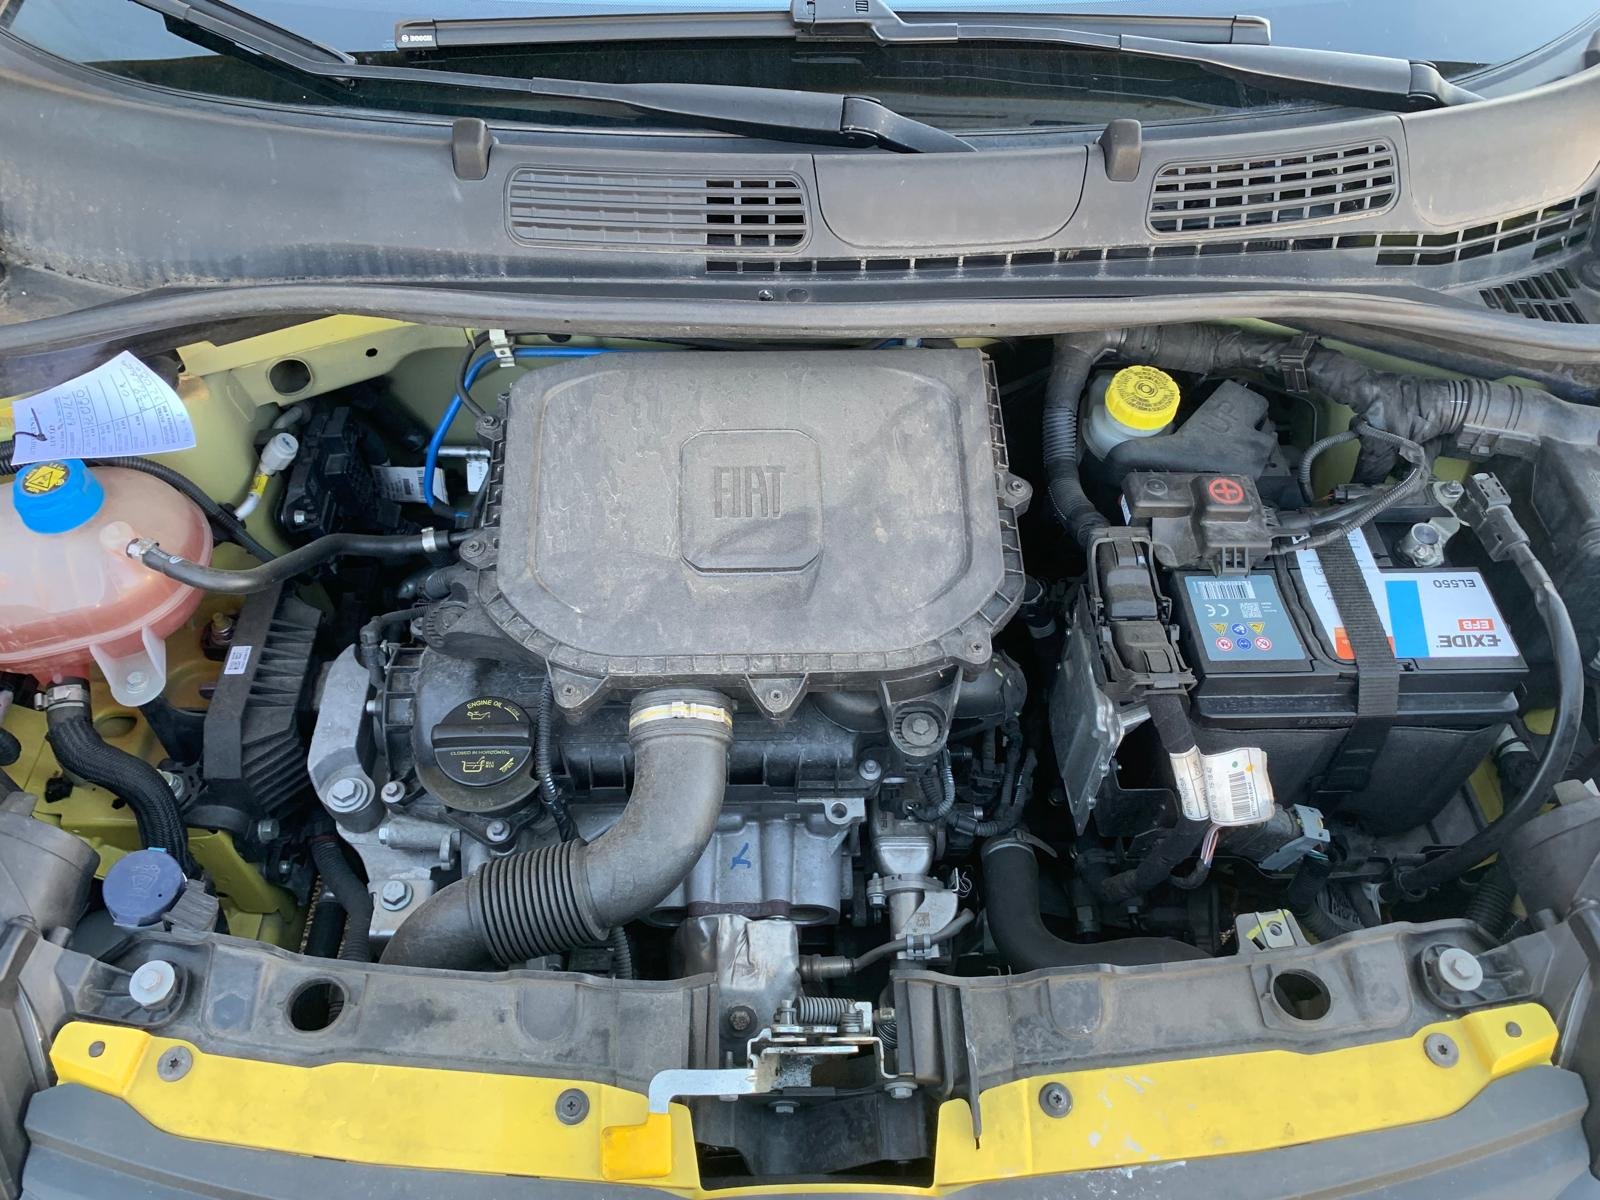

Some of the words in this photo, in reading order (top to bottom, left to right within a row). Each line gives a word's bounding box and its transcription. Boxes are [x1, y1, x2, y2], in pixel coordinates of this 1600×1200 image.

[713, 465, 786, 519] FIAT
[1432, 579, 1477, 589] EL550
[1462, 620, 1490, 630] EFB
[1437, 634, 1502, 648] EXIDE
[466, 699, 492, 709] ENGINE
[493, 700, 502, 709] OIL
